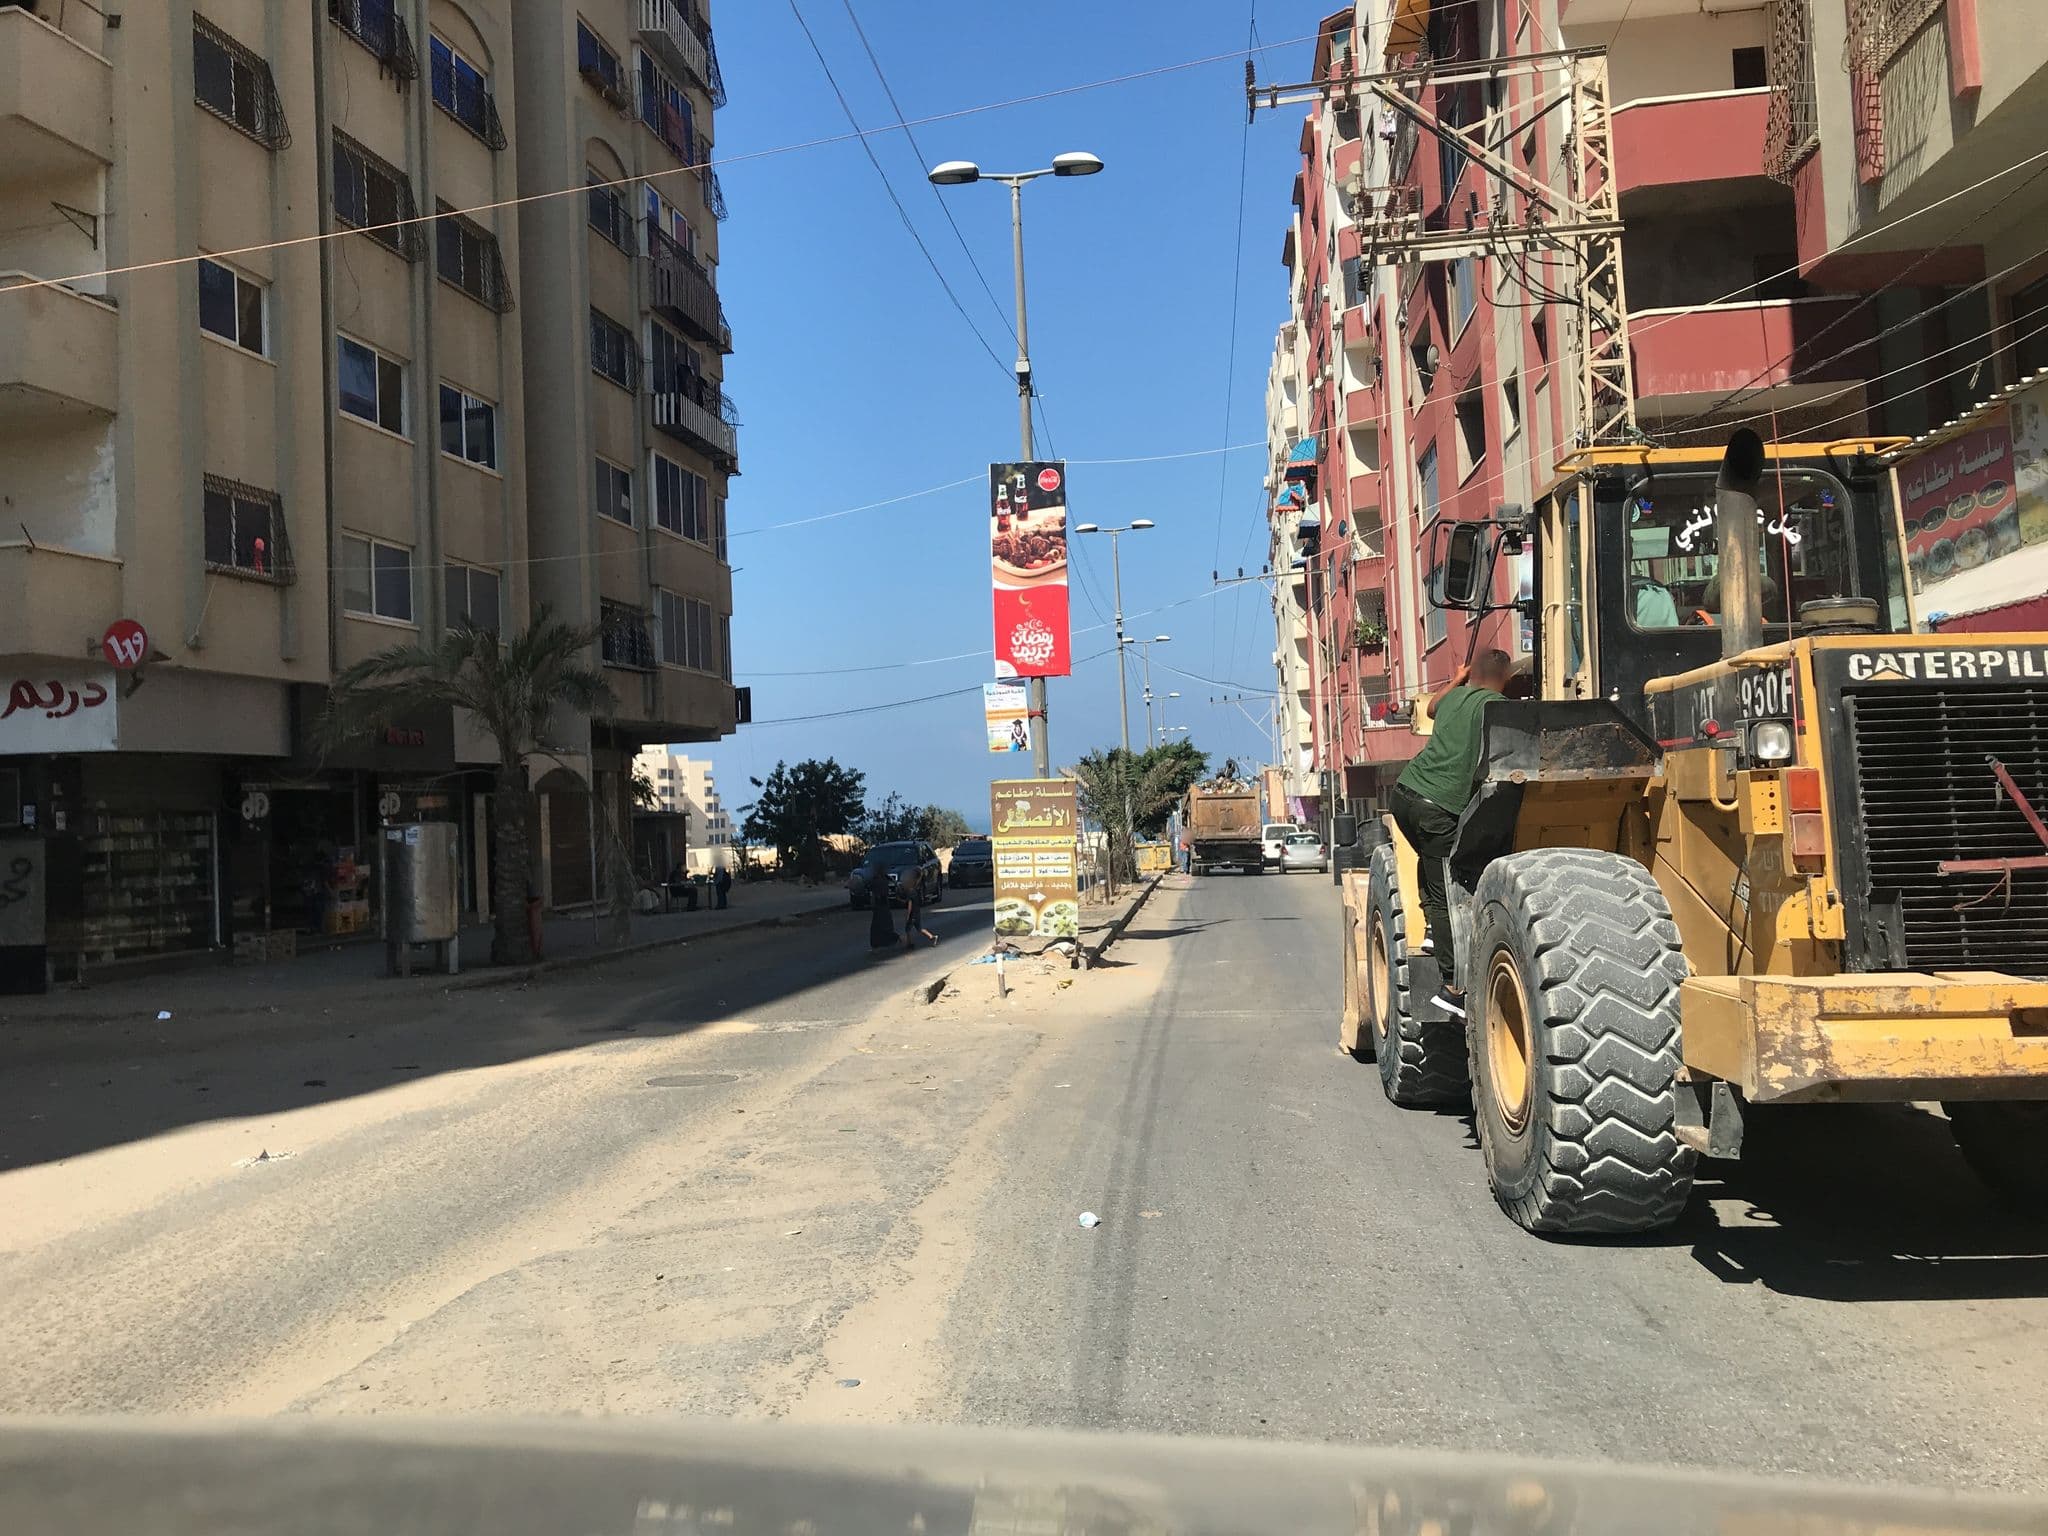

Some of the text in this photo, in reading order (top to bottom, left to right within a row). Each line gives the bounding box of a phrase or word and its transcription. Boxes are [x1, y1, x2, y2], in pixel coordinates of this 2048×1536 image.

[1011, 629, 1054, 646] رمضان
[1849, 650, 2048, 680] CATERPIL
[0, 680, 107, 719] دريم
[1741, 668, 1792, 718] 950F
[995, 786, 1072, 800] سلسلة مطاعم
